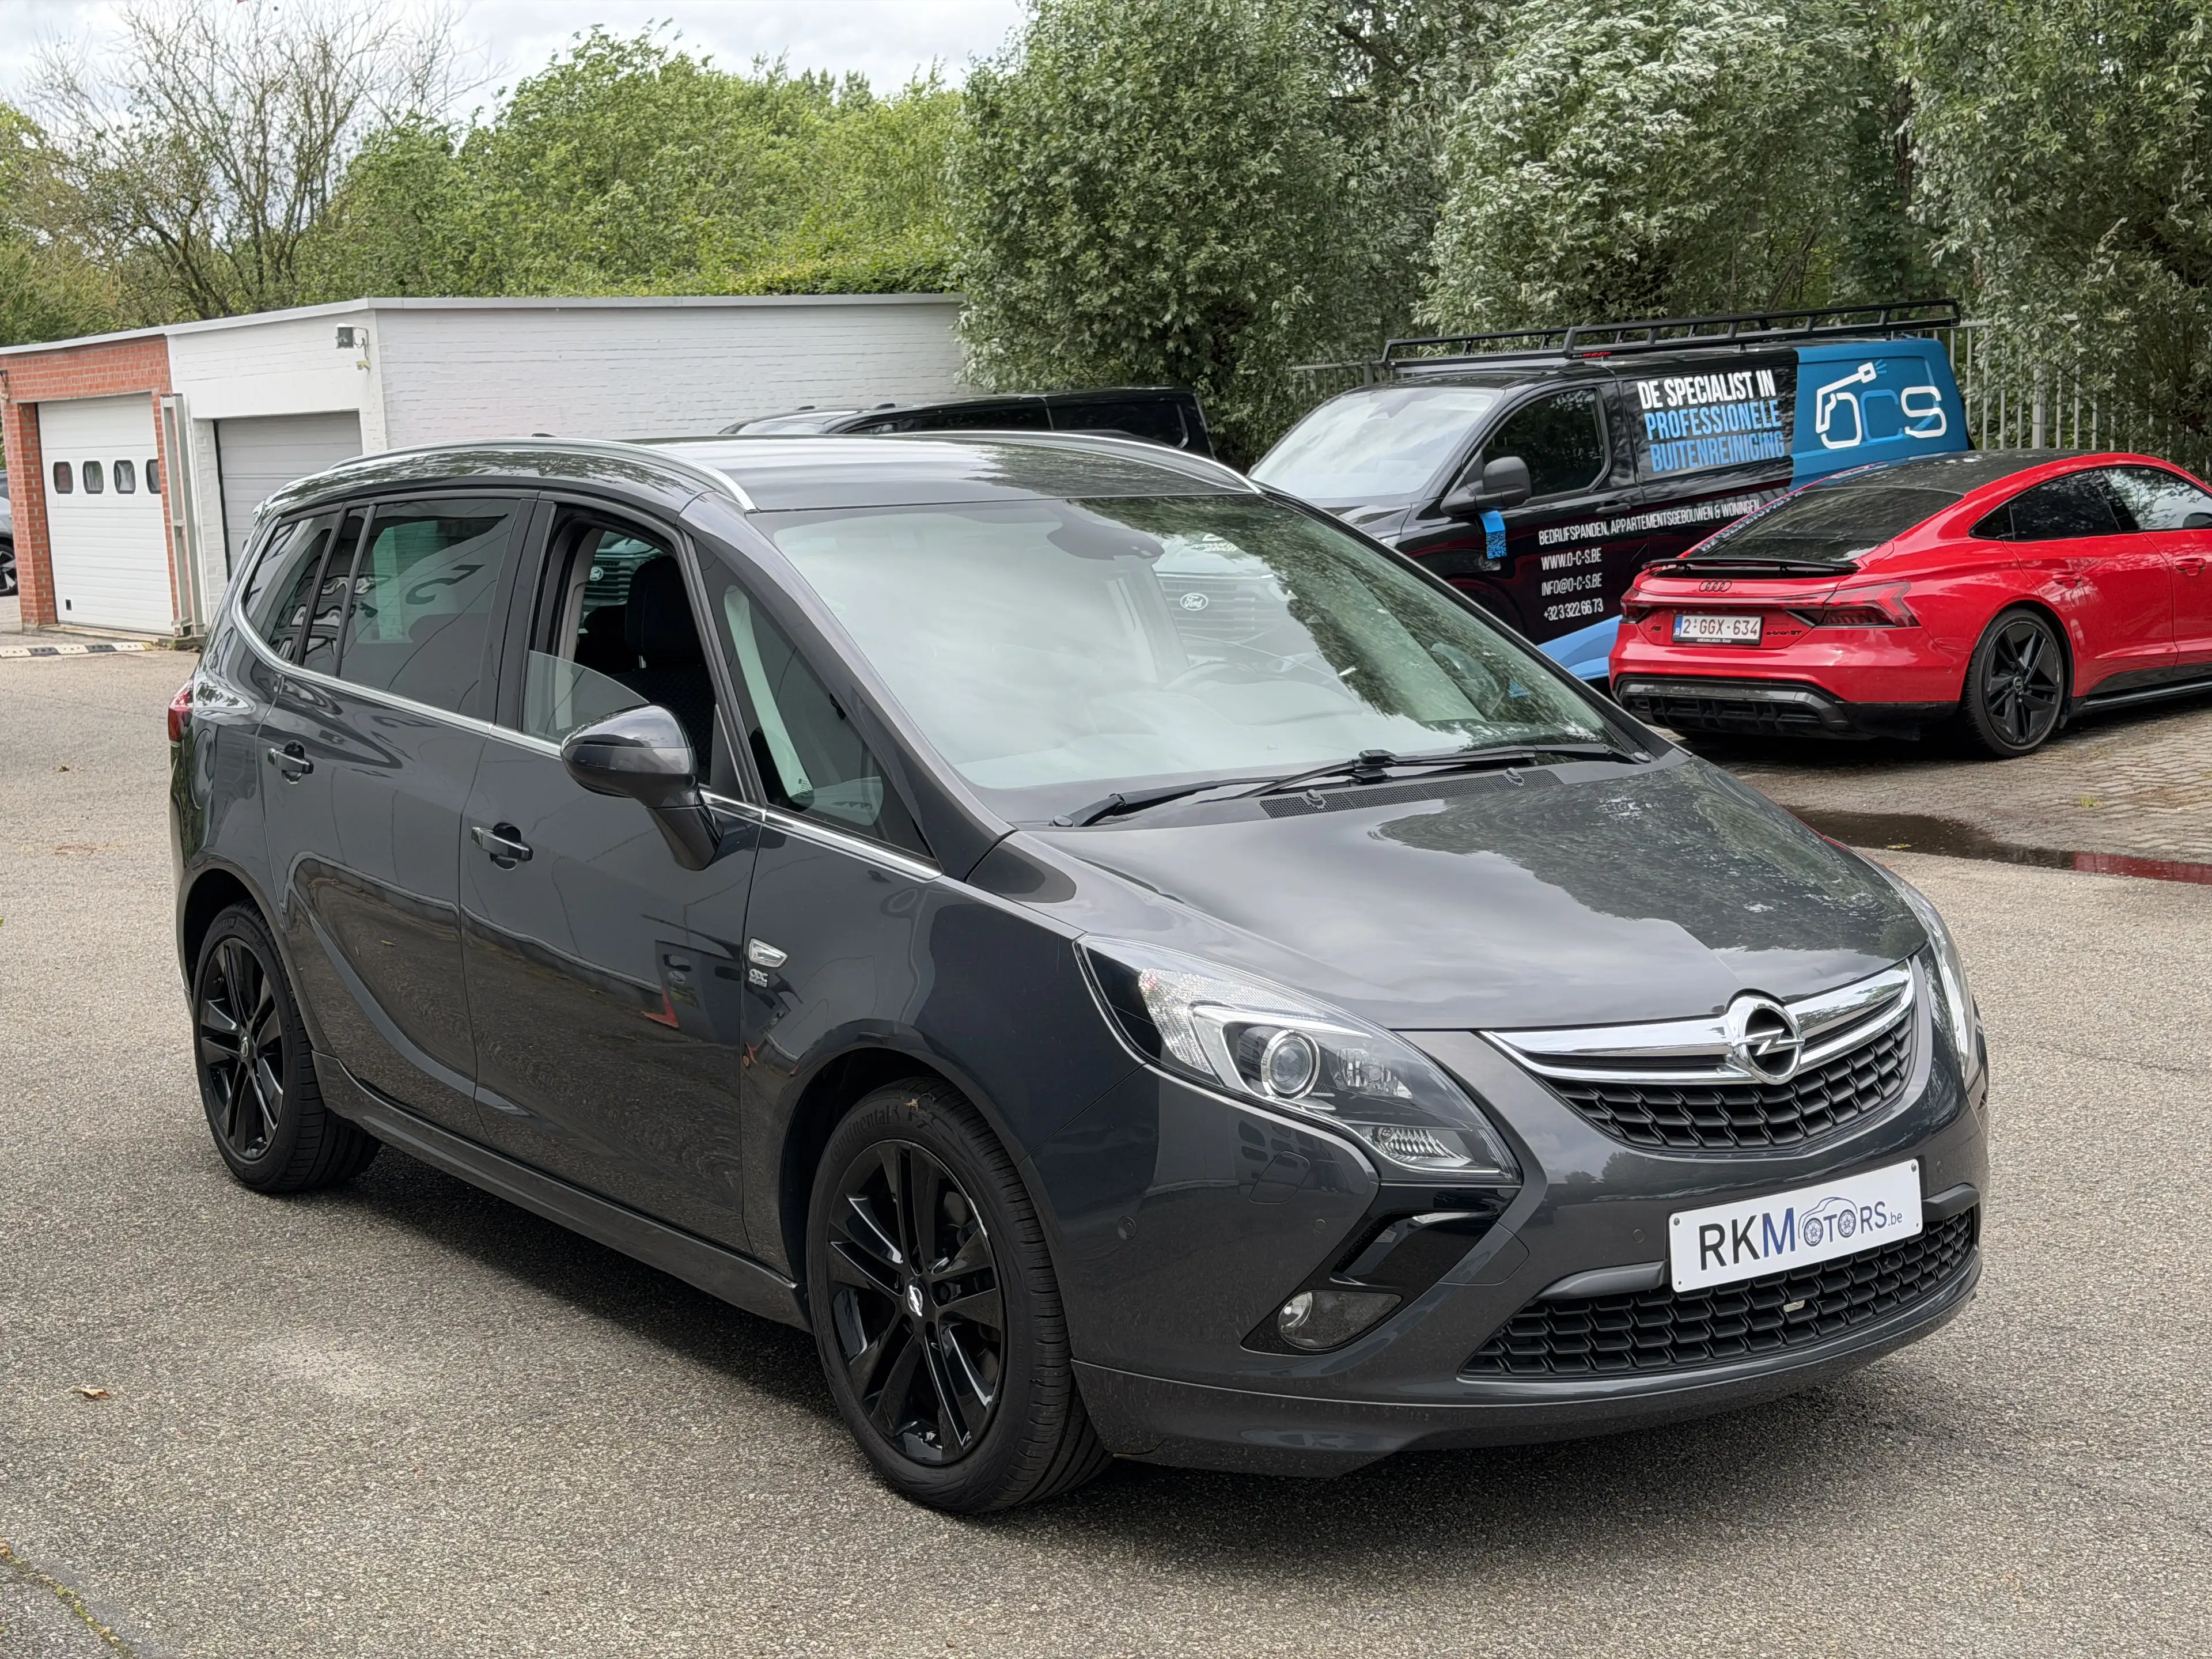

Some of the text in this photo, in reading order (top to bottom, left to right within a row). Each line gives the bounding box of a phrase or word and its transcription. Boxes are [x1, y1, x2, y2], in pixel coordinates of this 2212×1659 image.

[1637, 369, 1777, 410] DE SPECIALIST IN
[1644, 400, 1783, 441] PROFESSIONELE
[1649, 430, 1786, 472] BUITENREINIGING
[1611, 505, 1714, 535] APPARTEMENTSGEBOUWEN
[1715, 504, 1721, 518] &
[1721, 499, 1760, 517] WONINGEN
[1541, 547, 1602, 571] WWW.O-C-S.BE
[1541, 573, 1603, 596] INFO@O-C-S.BE
[1543, 597, 1604, 621] +32 3 322 66 73
[831, 1104, 891, 1164] Continental
